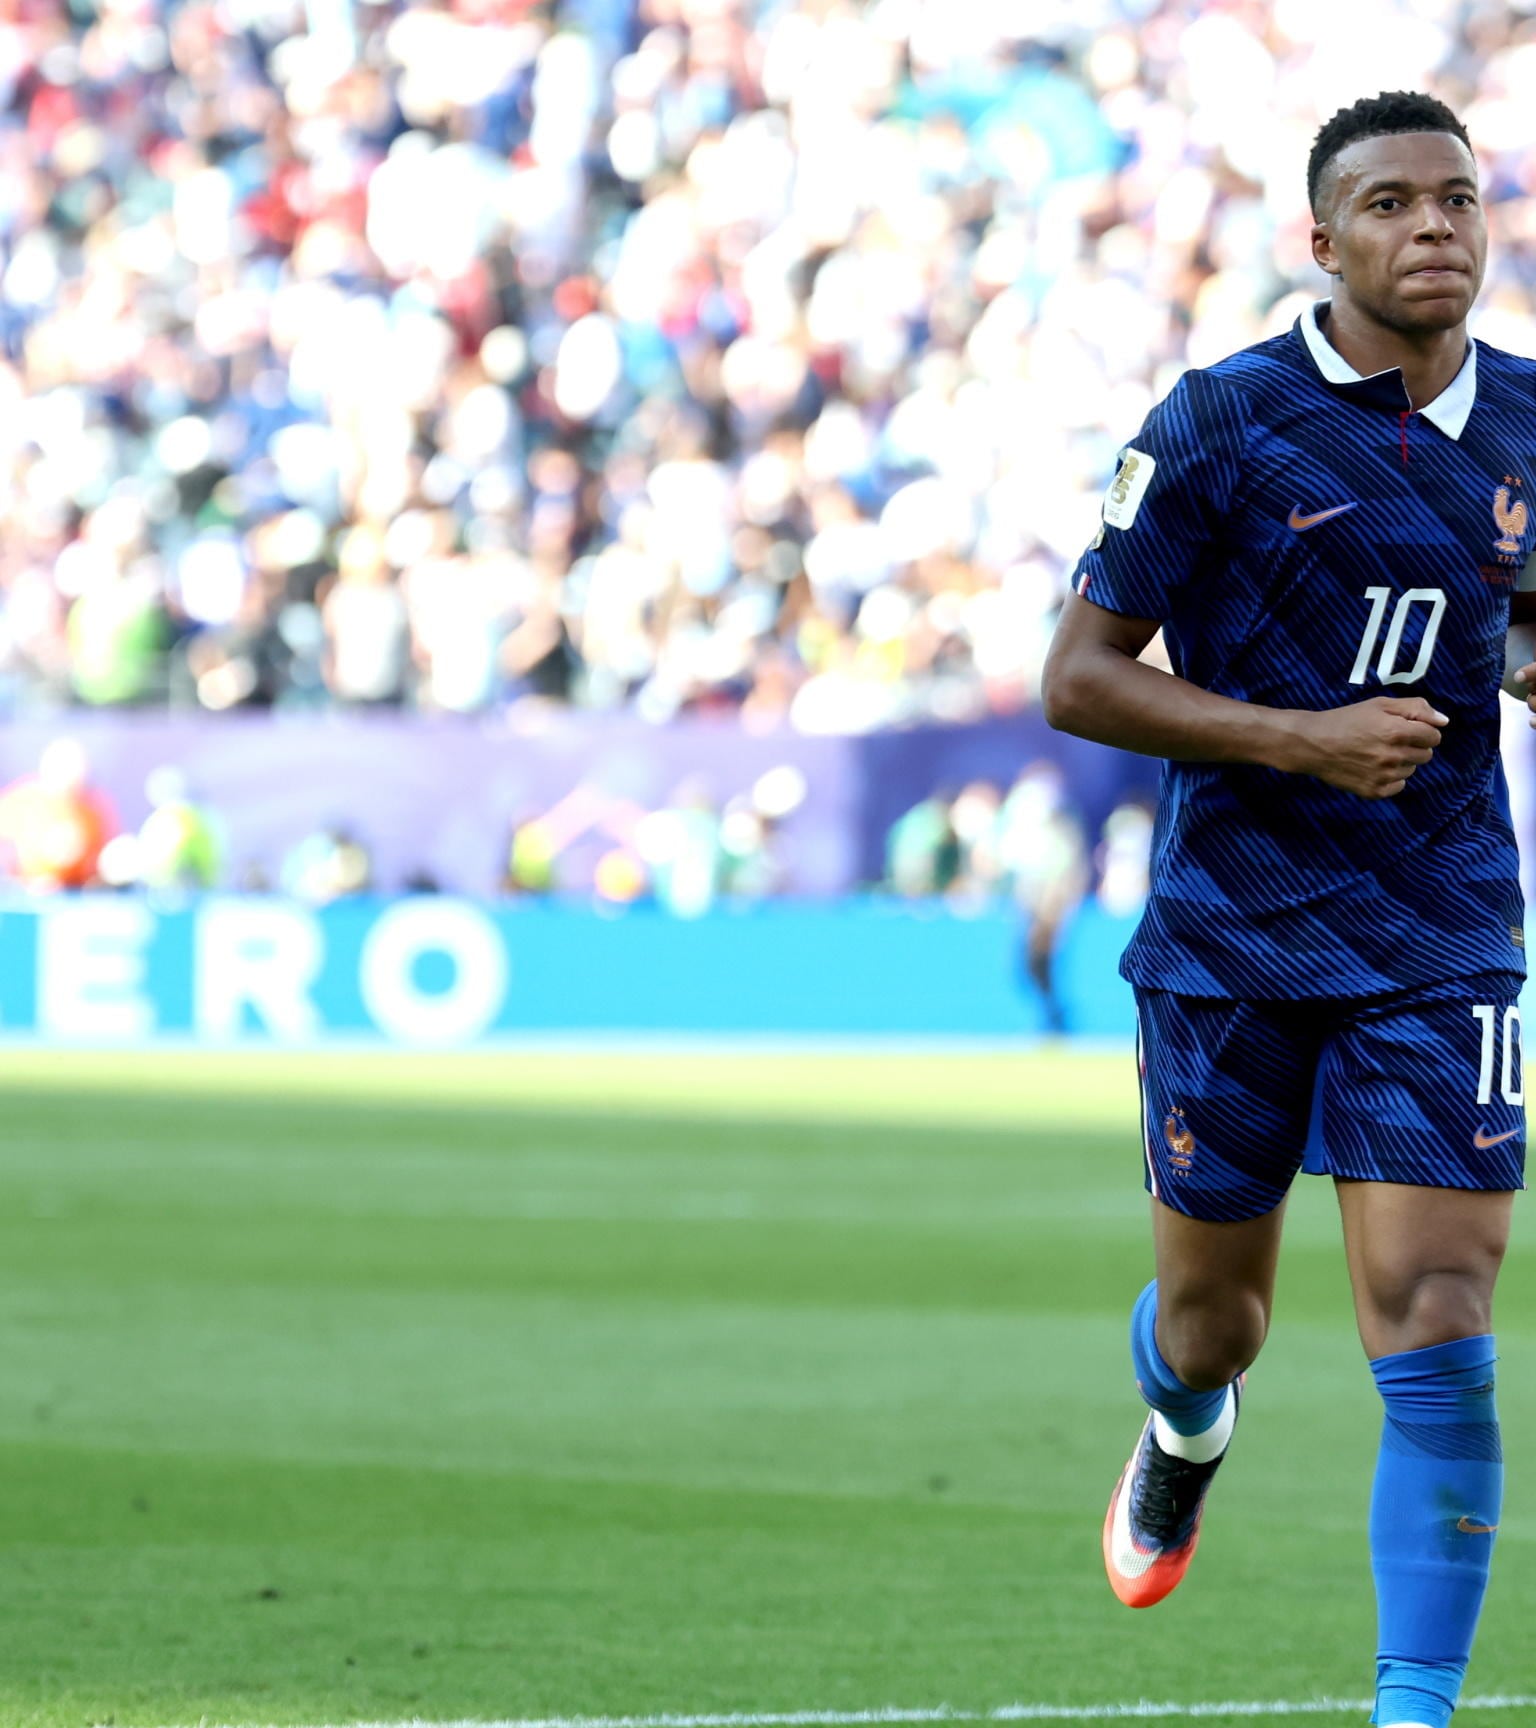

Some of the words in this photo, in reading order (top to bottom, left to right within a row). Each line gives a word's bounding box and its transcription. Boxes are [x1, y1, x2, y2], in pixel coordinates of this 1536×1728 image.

[1349, 586, 1447, 685] 10
[0, 898, 510, 1046] ERO
[1472, 1005, 1524, 1106] 10
